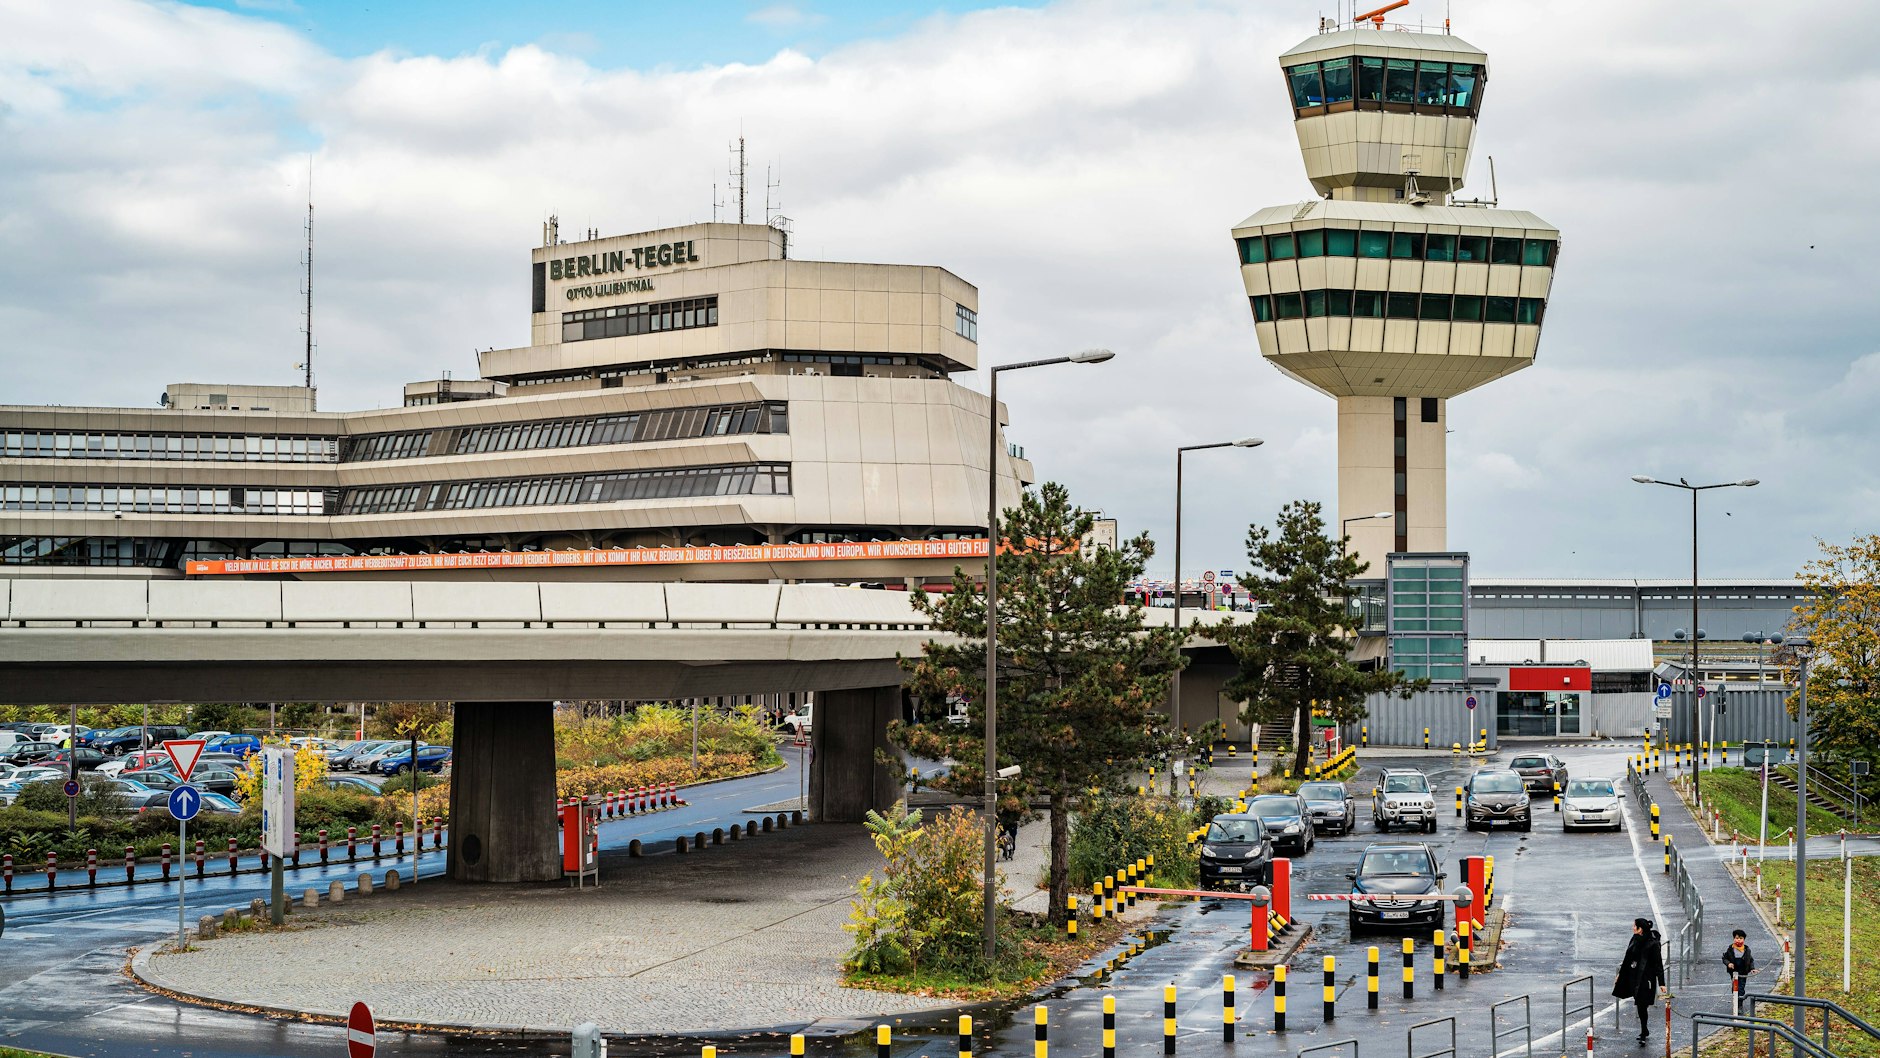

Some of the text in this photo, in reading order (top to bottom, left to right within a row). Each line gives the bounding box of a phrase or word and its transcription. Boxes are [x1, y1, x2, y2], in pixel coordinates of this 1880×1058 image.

[550, 240, 699, 280] BERLIN-TEGEL
[566, 278, 655, 300] OTTO LILIENTHAL
[224, 562, 239, 572] VIELEN
[240, 562, 252, 571] DANK
[252, 561, 259, 571] AN
[259, 561, 270, 572] ALLE,
[271, 561, 279, 570] DIE
[280, 560, 290, 570] SICH
[314, 559, 333, 570] MACHEN,
[334, 559, 348, 569] DIESE
[348, 558, 364, 568] LANGE
[364, 557, 408, 568] WERBEBOTSCHAFT
[408, 557, 416, 567] ZU
[416, 556, 433, 567] LESEN.
[434, 556, 443, 566] IHR
[444, 556, 458, 566] HABT
[458, 556, 472, 566] EUCH
[473, 555, 487, 565] JETZT
[488, 555, 501, 565] ECHT
[502, 554, 524, 565] URLAUB
[524, 554, 550, 564] VERDIENT.
[584, 553, 594, 563] MIT
[594, 552, 606, 563] UNS
[608, 552, 629, 563] KOMMT
[630, 551, 640, 561] IHR
[642, 551, 658, 561] GANZ
[660, 550, 684, 561] BEQUEM
[686, 550, 693, 560] ZU
[695, 549, 712, 560] ÜBER
[714, 549, 721, 560] 90
[723, 548, 762, 560] REISEZIELEN
[764, 548, 770, 558] IN
[772, 546, 819, 558] DEUTSCHLAND
[821, 546, 835, 557] UND
[837, 545, 866, 557] EUROPA.
[868, 545, 881, 556] WIR
[883, 543, 923, 556] WÜNSCHEN
[925, 543, 946, 554] EINEN
[948, 542, 972, 554] GUTEN
[974, 542, 989, 554] FLU
